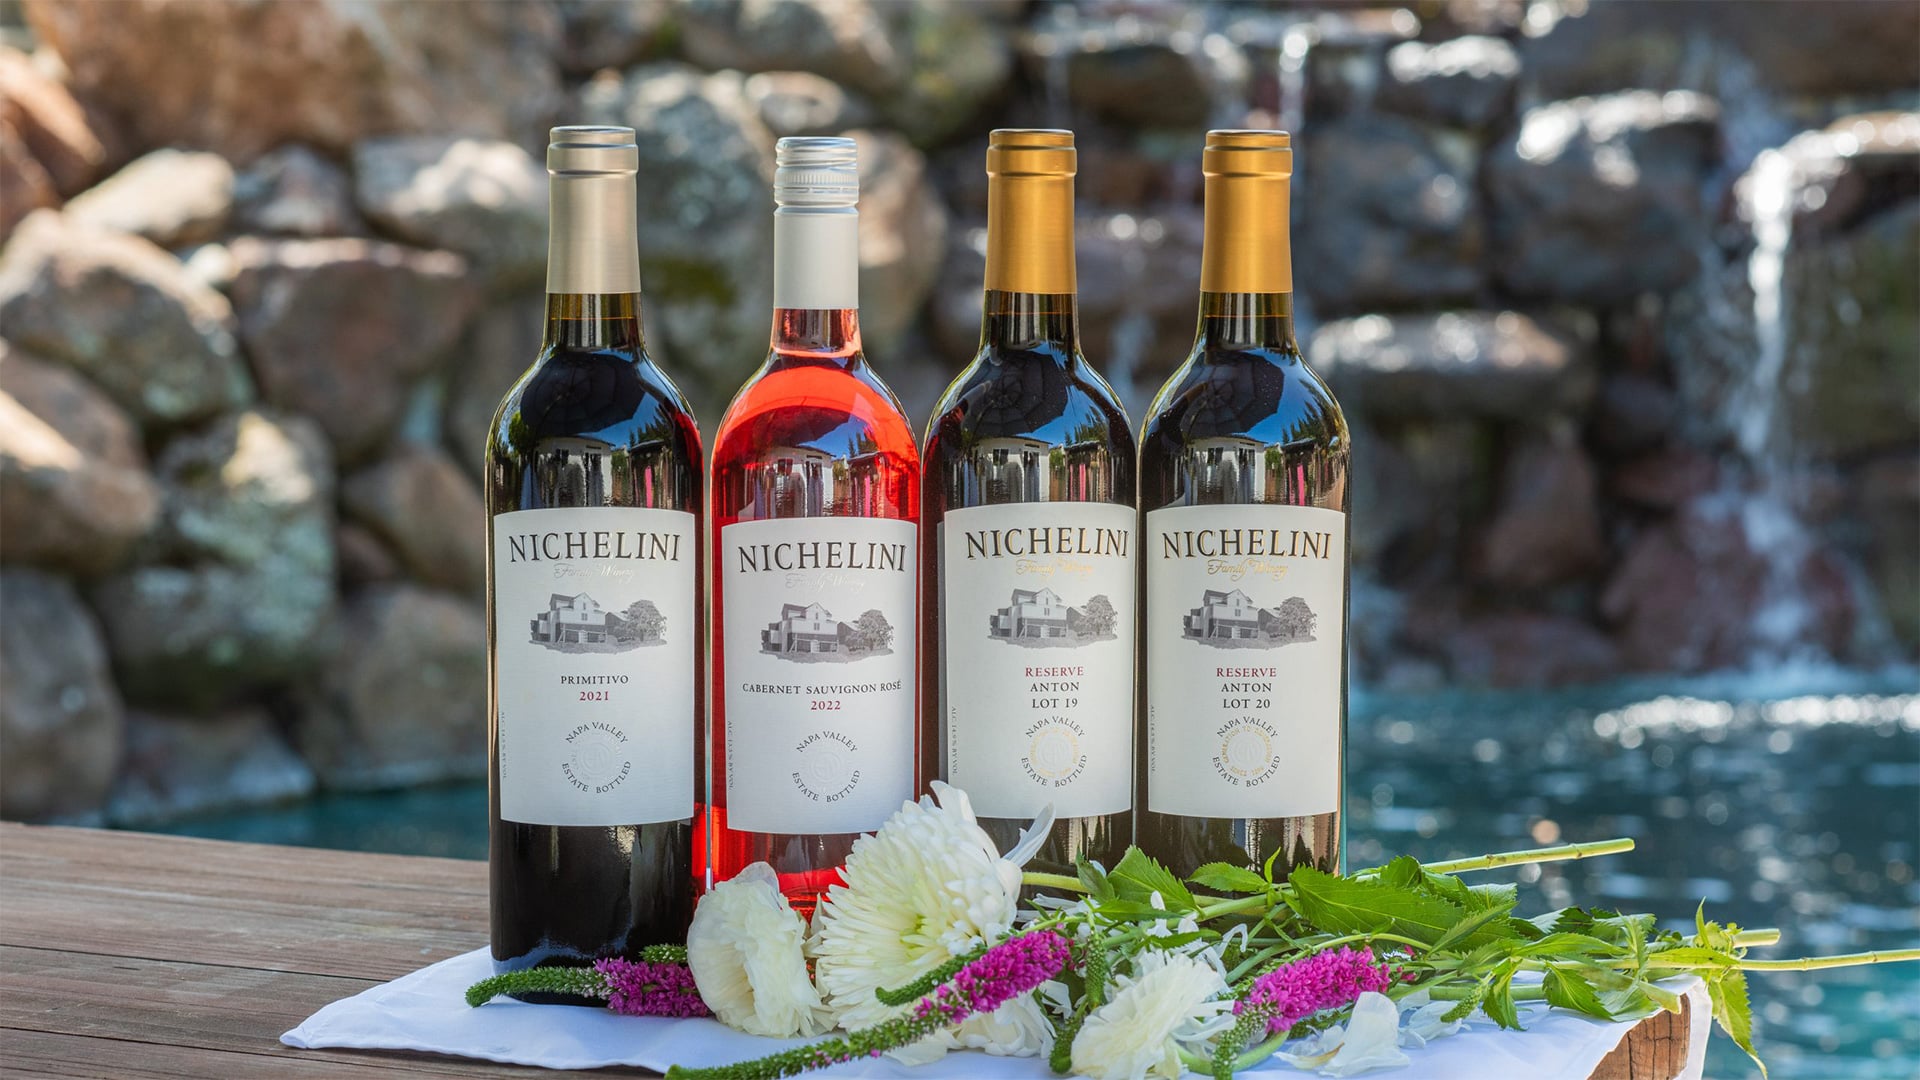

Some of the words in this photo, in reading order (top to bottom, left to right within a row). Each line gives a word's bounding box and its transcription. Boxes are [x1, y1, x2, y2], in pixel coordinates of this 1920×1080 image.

[508, 532, 681, 562] NICHELINI
[965, 527, 1129, 560] NICHELINI
[1162, 529, 1332, 560] NICHELINI
[738, 542, 907, 573] NICHELINI
[1207, 559, 1249, 581] Family
[1248, 560, 1289, 582] Winery
[561, 675, 629, 685] PRIMITIVO
[1025, 667, 1084, 677] RESERVE
[1216, 668, 1277, 677] RESERVE
[579, 691, 609, 701] 2021
[742, 684, 801, 694] CABERNET
[806, 684, 877, 694] SAUVIGNON
[880, 680, 901, 691] ROSÉ
[1030, 682, 1080, 692] ANTON
[1221, 683, 1272, 692] ANTON
[811, 701, 841, 711] 2022
[1032, 698, 1059, 709] LOT
[1066, 698, 1078, 708] 19
[1223, 699, 1250, 709] LOT
[1256, 699, 1270, 709] 20
[565, 724, 590, 744] NAPA
[592, 722, 629, 744] VALLEY
[1026, 718, 1050, 738] NAPA
[1052, 716, 1085, 737] VALLEY
[1217, 718, 1240, 738] NAPA
[1243, 716, 1279, 738] VALLEY
[796, 733, 820, 753] NAPA
[823, 731, 858, 753] VALLEY
[562, 762, 589, 792] ESTATE
[596, 761, 631, 794] BOTTLED
[1021, 757, 1048, 787] ESTATE
[1055, 754, 1087, 788] BOTTLED
[1213, 757, 1239, 786] ESTATE
[1246, 755, 1281, 788] BOTTLED
[792, 772, 819, 801] ESTATE
[826, 770, 860, 802] BOTTLED
